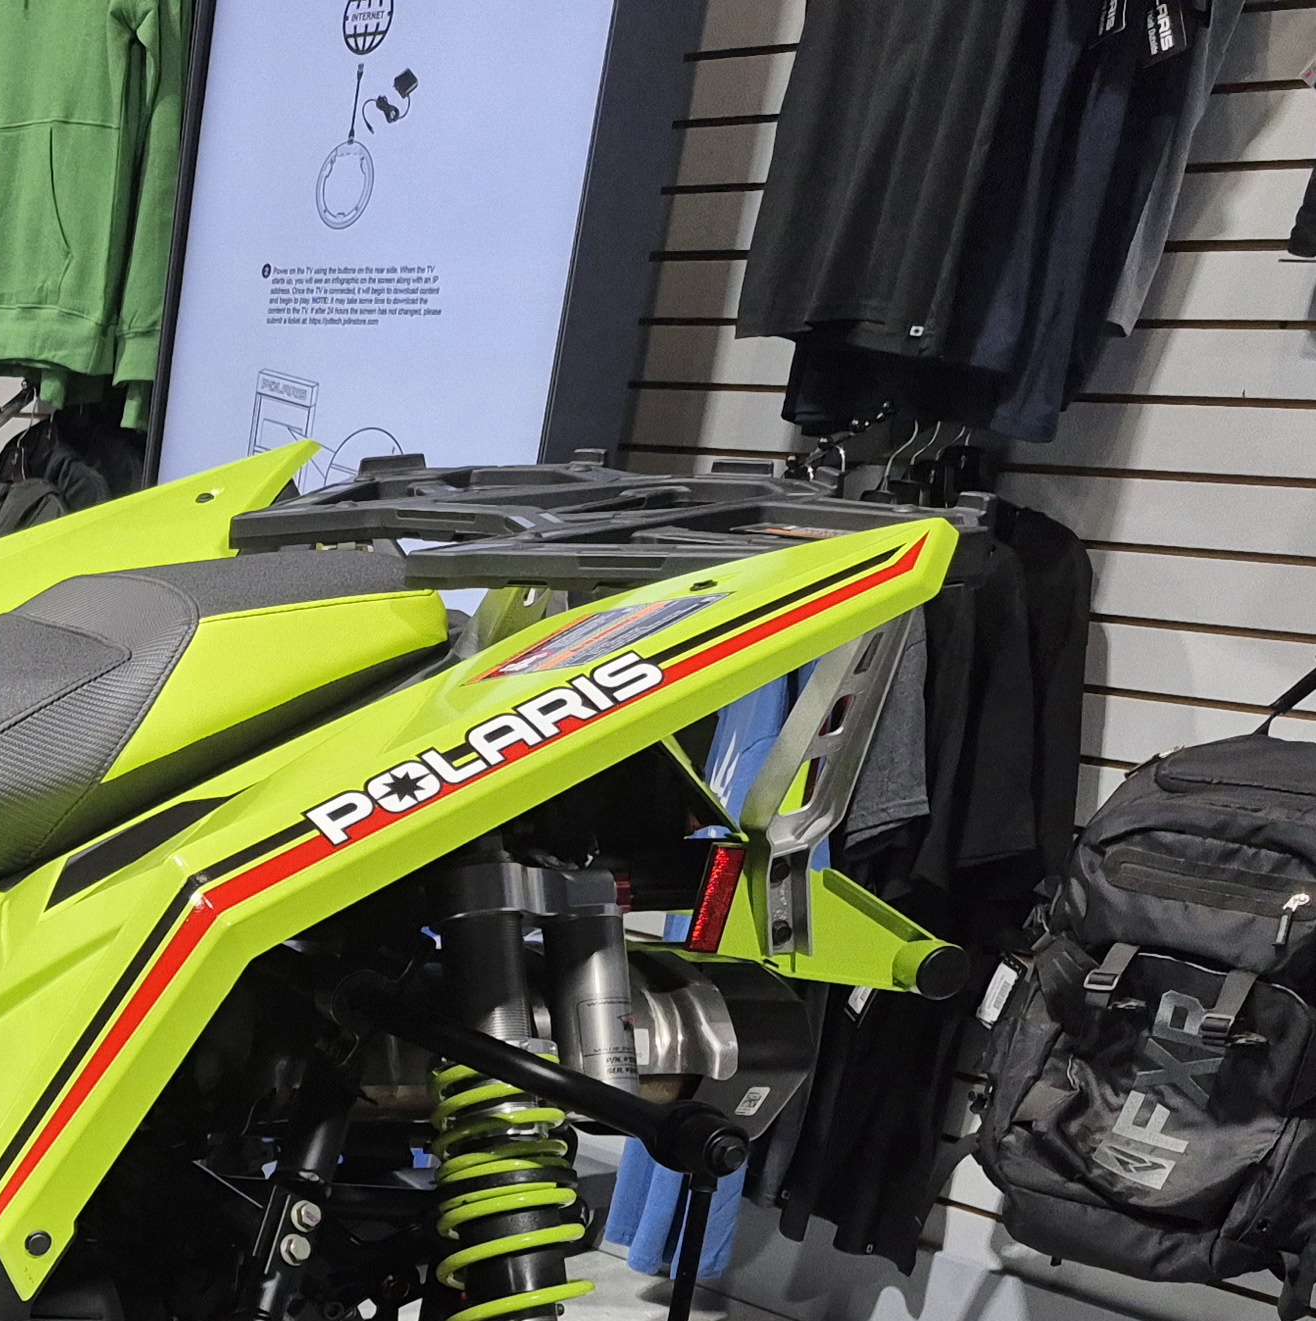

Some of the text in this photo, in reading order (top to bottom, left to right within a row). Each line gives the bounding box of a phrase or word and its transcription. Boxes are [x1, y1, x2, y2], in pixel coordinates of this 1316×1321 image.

[351, 10, 385, 22] INTERNET
[1156, 0, 1175, 52] ARIS
[306, 651, 666, 846] POLARIS
